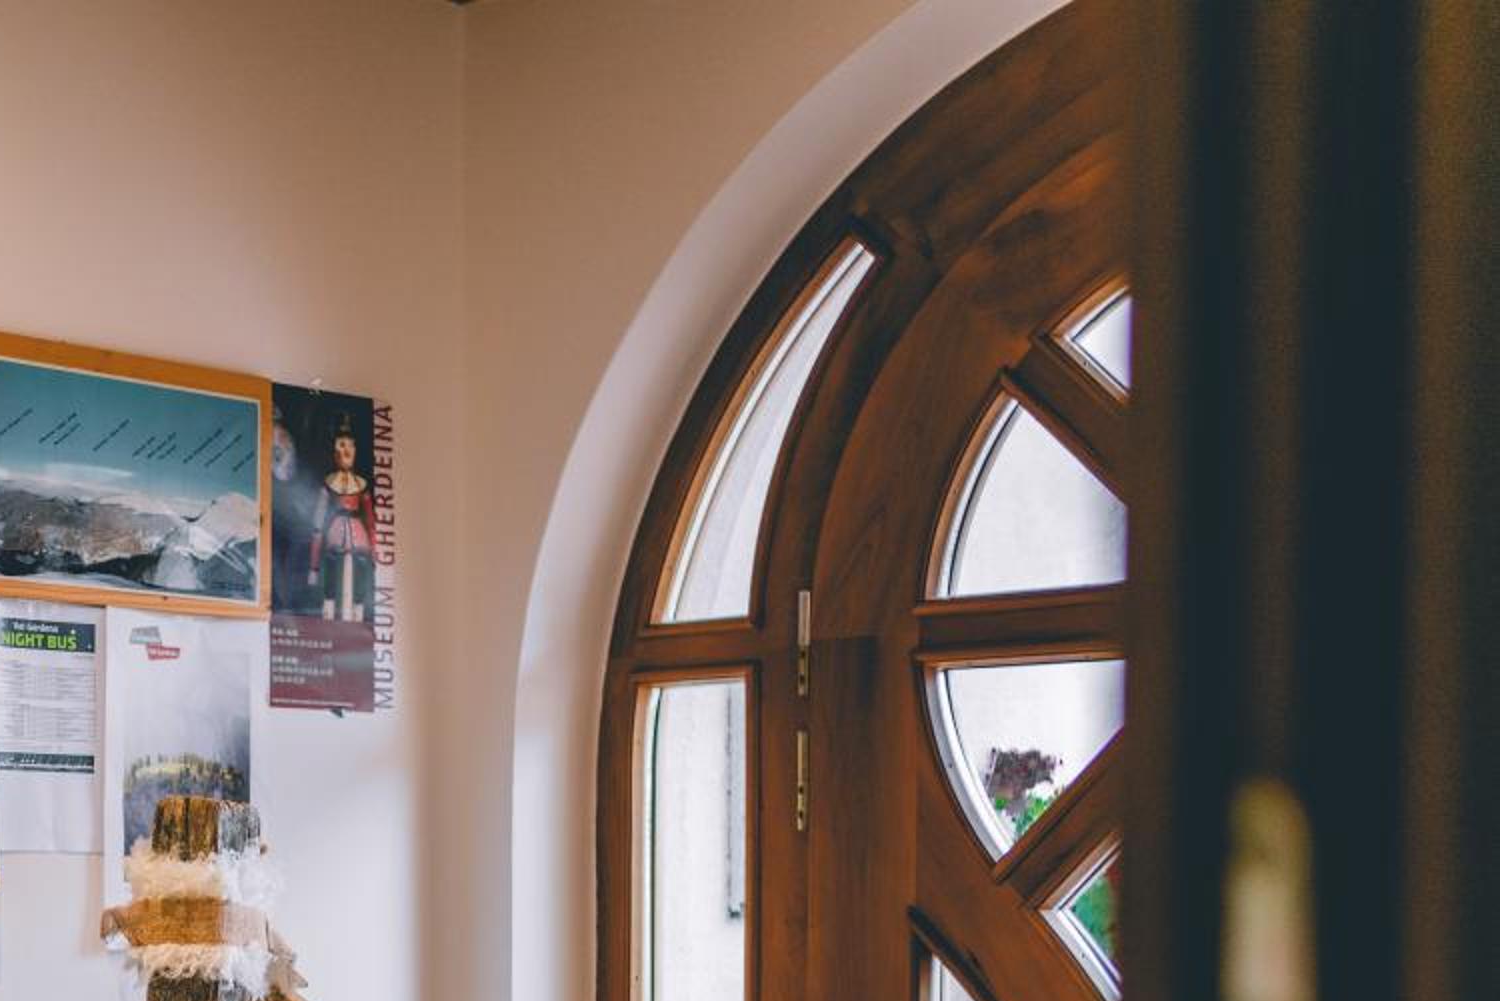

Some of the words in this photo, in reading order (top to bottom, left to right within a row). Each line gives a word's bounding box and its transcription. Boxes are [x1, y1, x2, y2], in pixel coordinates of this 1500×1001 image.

[374, 405, 395, 566] GHERDEINA
[2, 630, 45, 648] NIGHT
[47, 635, 77, 651] BUS
[373, 588, 395, 710] MUSEUM
